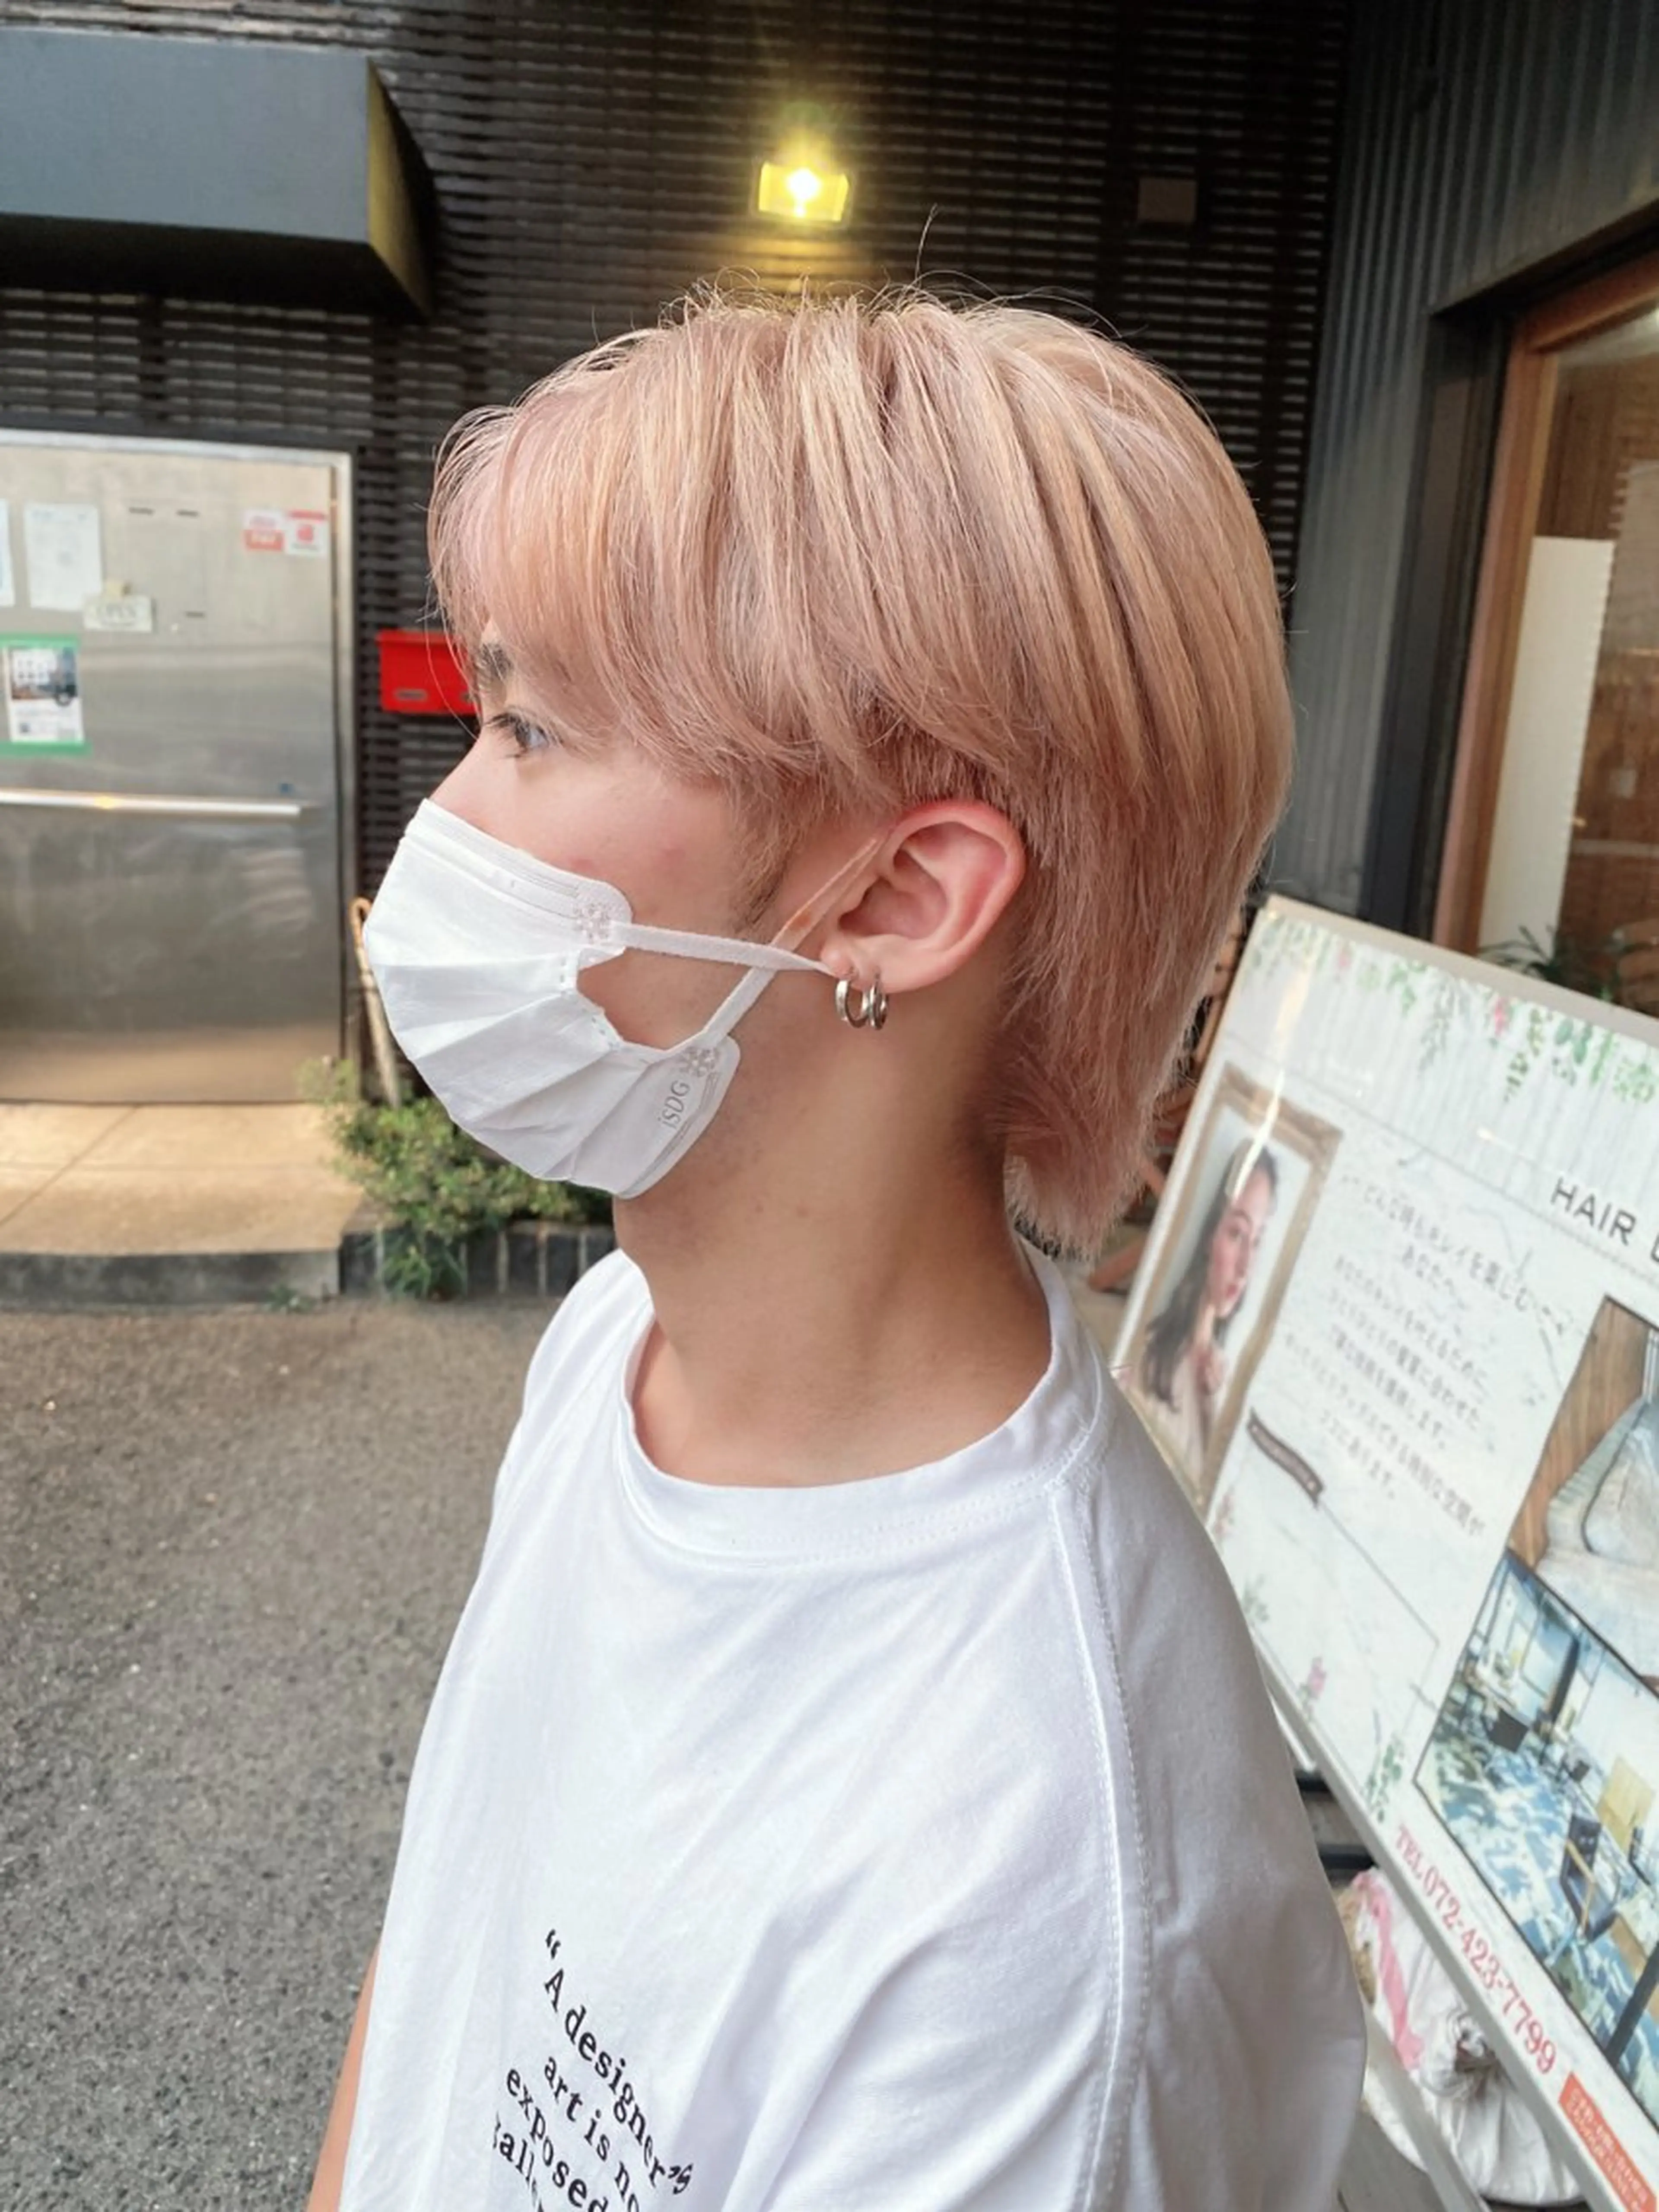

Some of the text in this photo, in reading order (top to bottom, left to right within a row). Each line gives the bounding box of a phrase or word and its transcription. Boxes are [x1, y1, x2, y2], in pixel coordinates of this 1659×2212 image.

[1550, 1176, 1637, 1246] HAIR
[544, 2057, 583, 2123] art
[584, 2109, 610, 2162] is
[565, 2005, 693, 2196] designer’s
